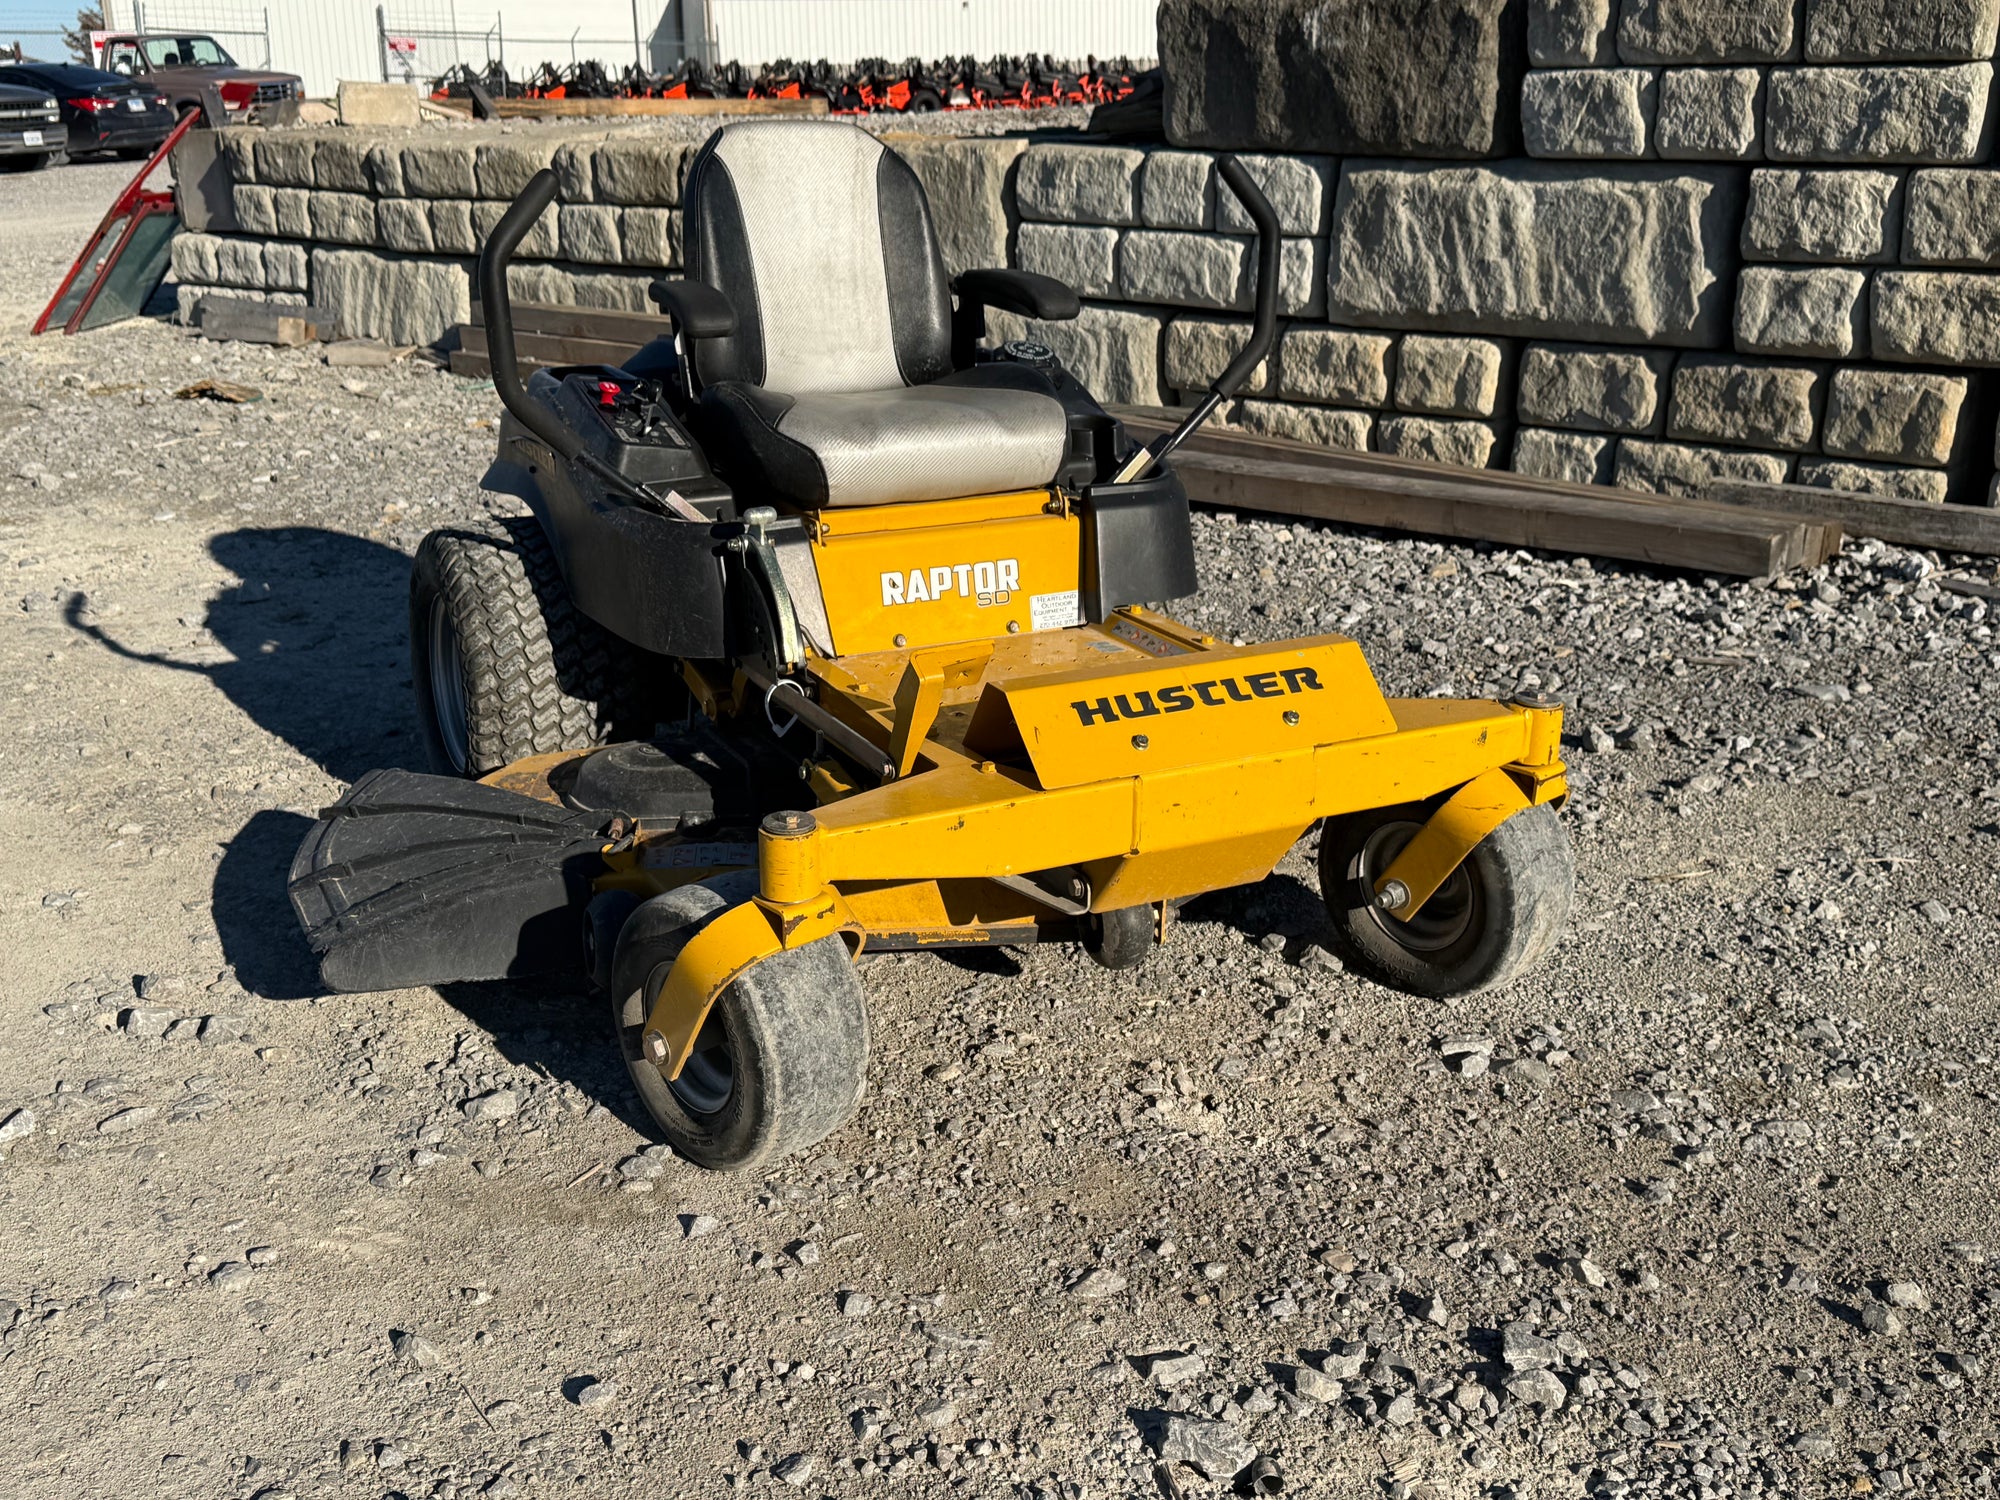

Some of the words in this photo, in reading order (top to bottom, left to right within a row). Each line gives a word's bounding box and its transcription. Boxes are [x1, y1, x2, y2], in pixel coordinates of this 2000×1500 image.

[880, 558, 1021, 606] RAPTOR
[977, 589, 1010, 607] SD
[1037, 593, 1077, 603] HEARTLAND
[1041, 600, 1073, 609] OUTDOOR
[1070, 666, 1325, 727] HUSTLER
